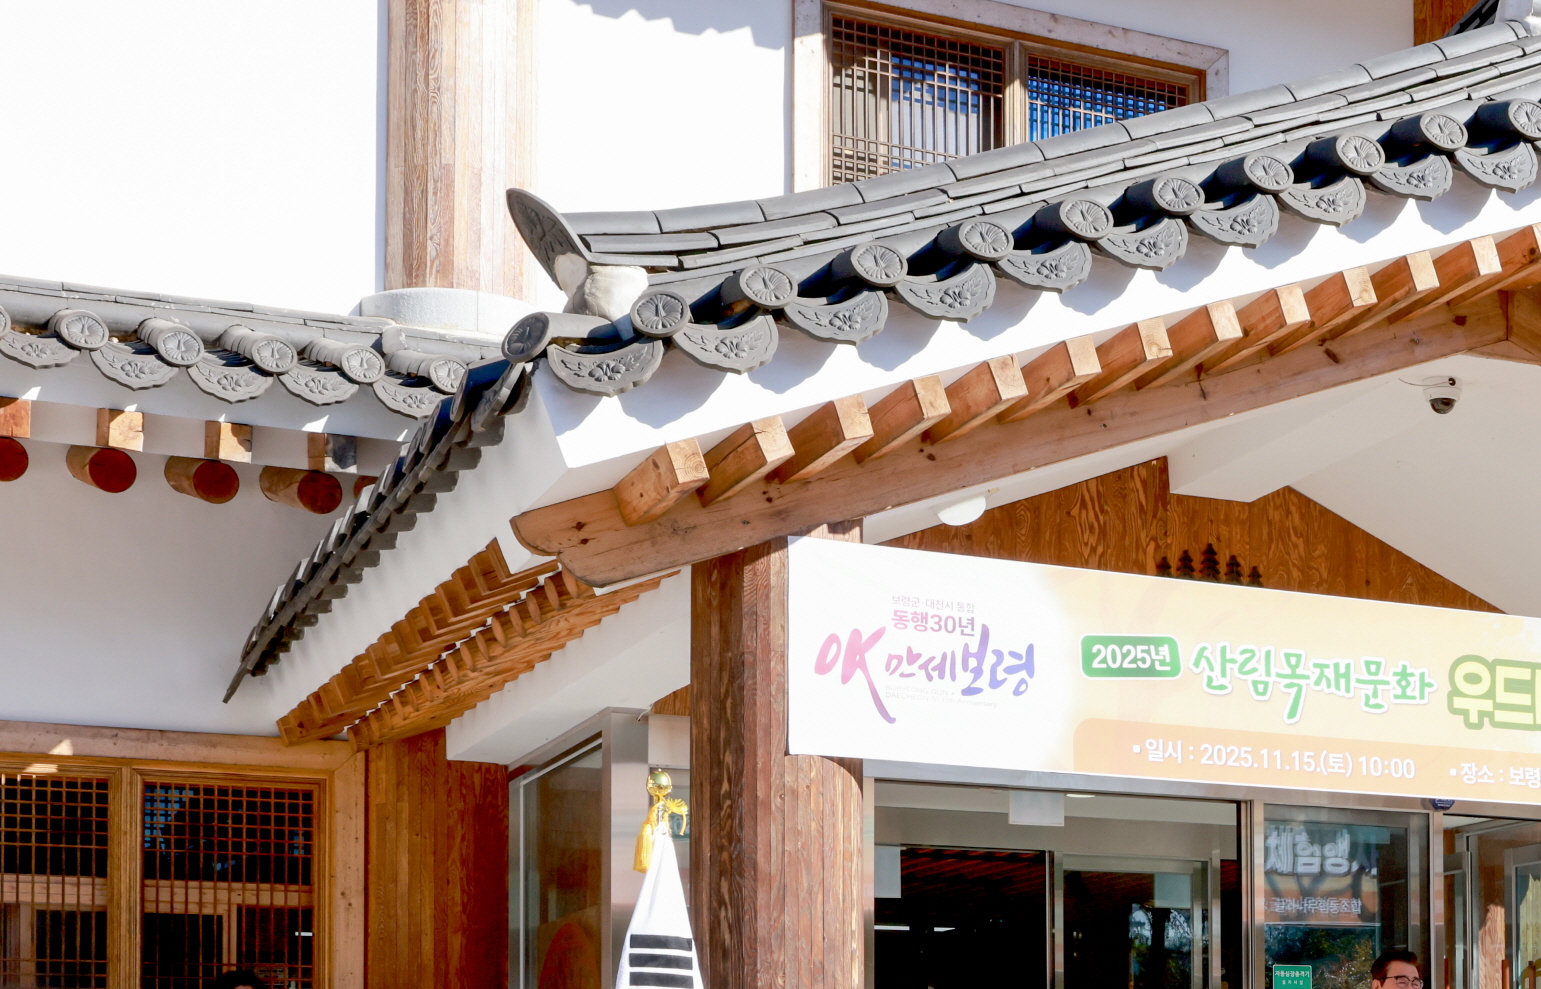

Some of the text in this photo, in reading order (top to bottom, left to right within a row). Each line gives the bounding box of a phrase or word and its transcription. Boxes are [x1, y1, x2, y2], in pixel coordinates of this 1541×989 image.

[891, 609, 975, 637] 동행30년
[814, 626, 896, 724] OK
[1091, 643, 1172, 671] 2025년
[1191, 643, 1436, 721] 산림목재문화
[1145, 738, 1183, 764] 일시
[1199, 743, 1353, 777] 2025.11.15.(토)
[1358, 755, 1416, 779] 10:00
[1460, 762, 1495, 784] 장소
